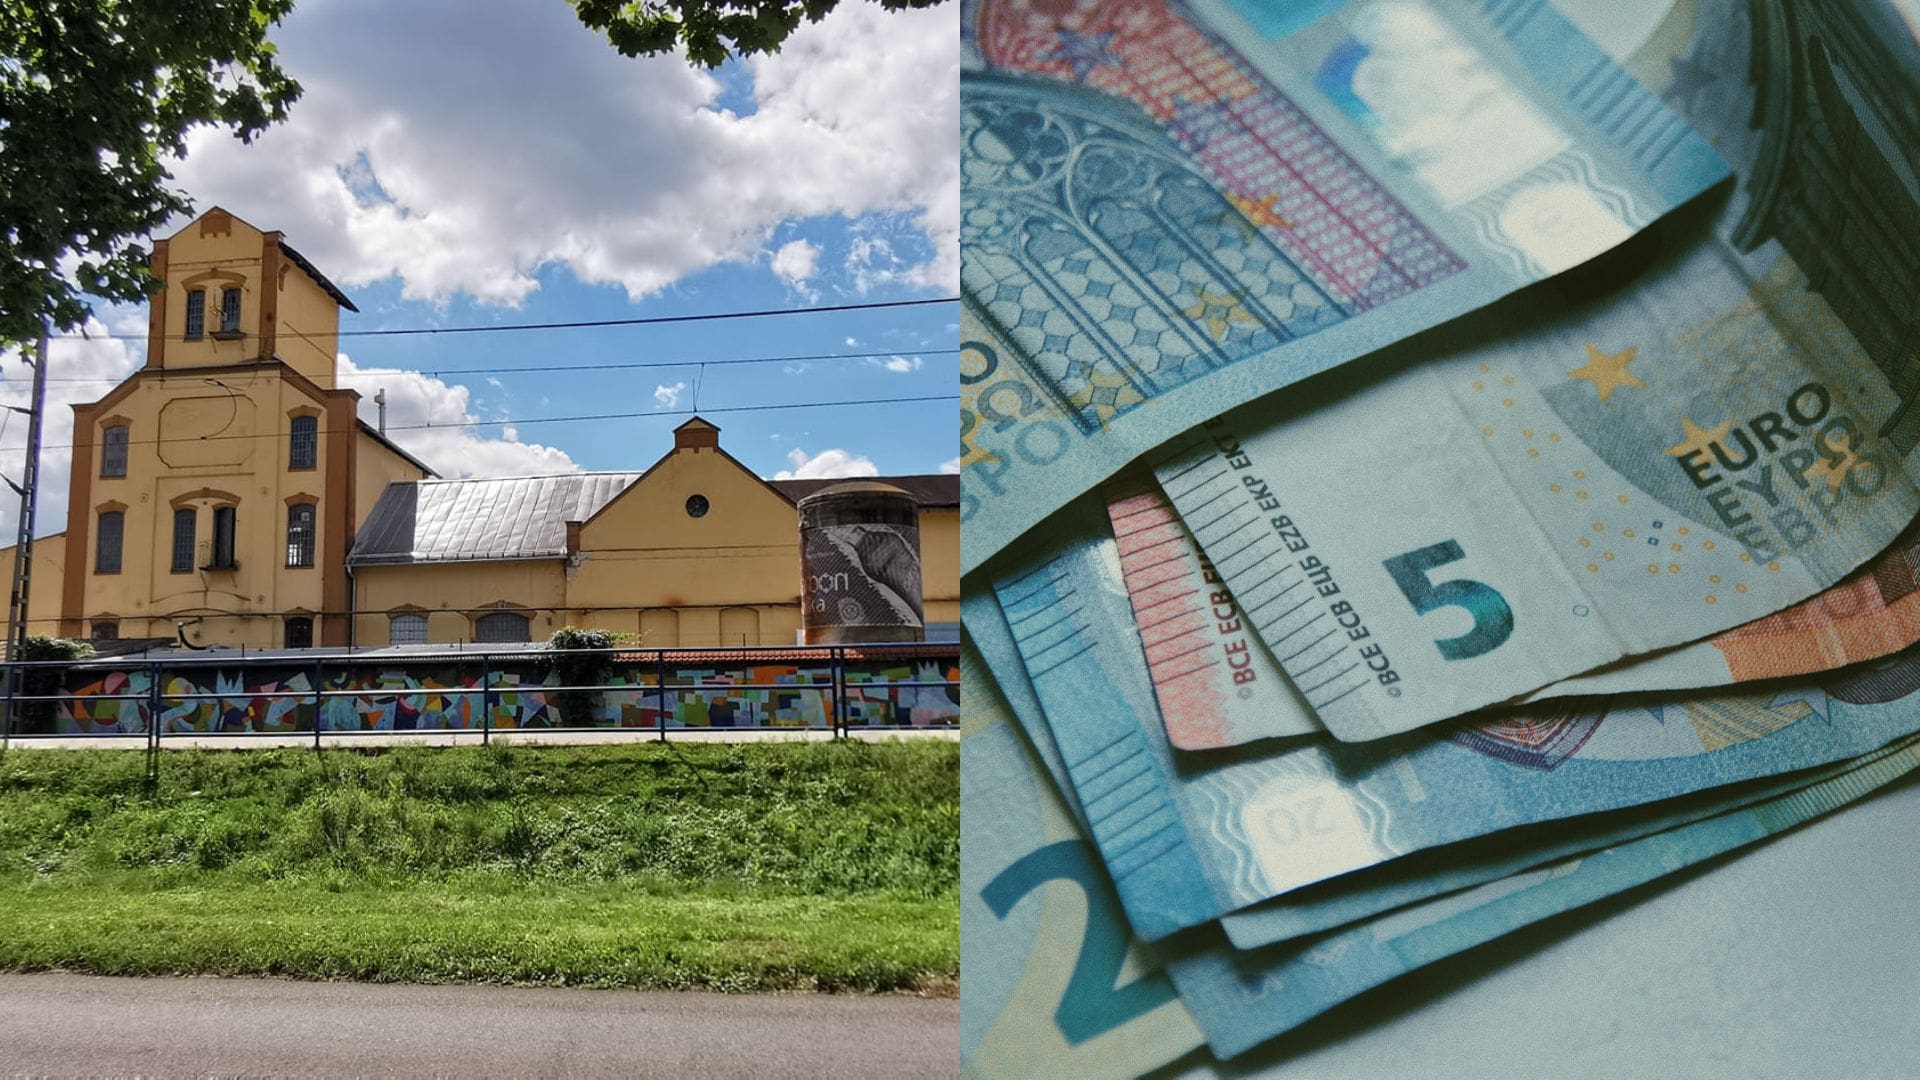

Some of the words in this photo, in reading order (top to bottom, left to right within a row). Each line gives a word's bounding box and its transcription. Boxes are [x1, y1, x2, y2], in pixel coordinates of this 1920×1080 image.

[1677, 382, 1831, 490] EURO
[1241, 474, 1281, 513] EKP
[1270, 513, 1310, 554] EZB
[1210, 588, 1242, 635] ECB
[1330, 599, 1371, 642] ECB
[1381, 538, 1515, 661] 5
[1224, 638, 1257, 686] BCE
[1359, 642, 1402, 687] BCE
[980, 838, 1179, 1047] 2
